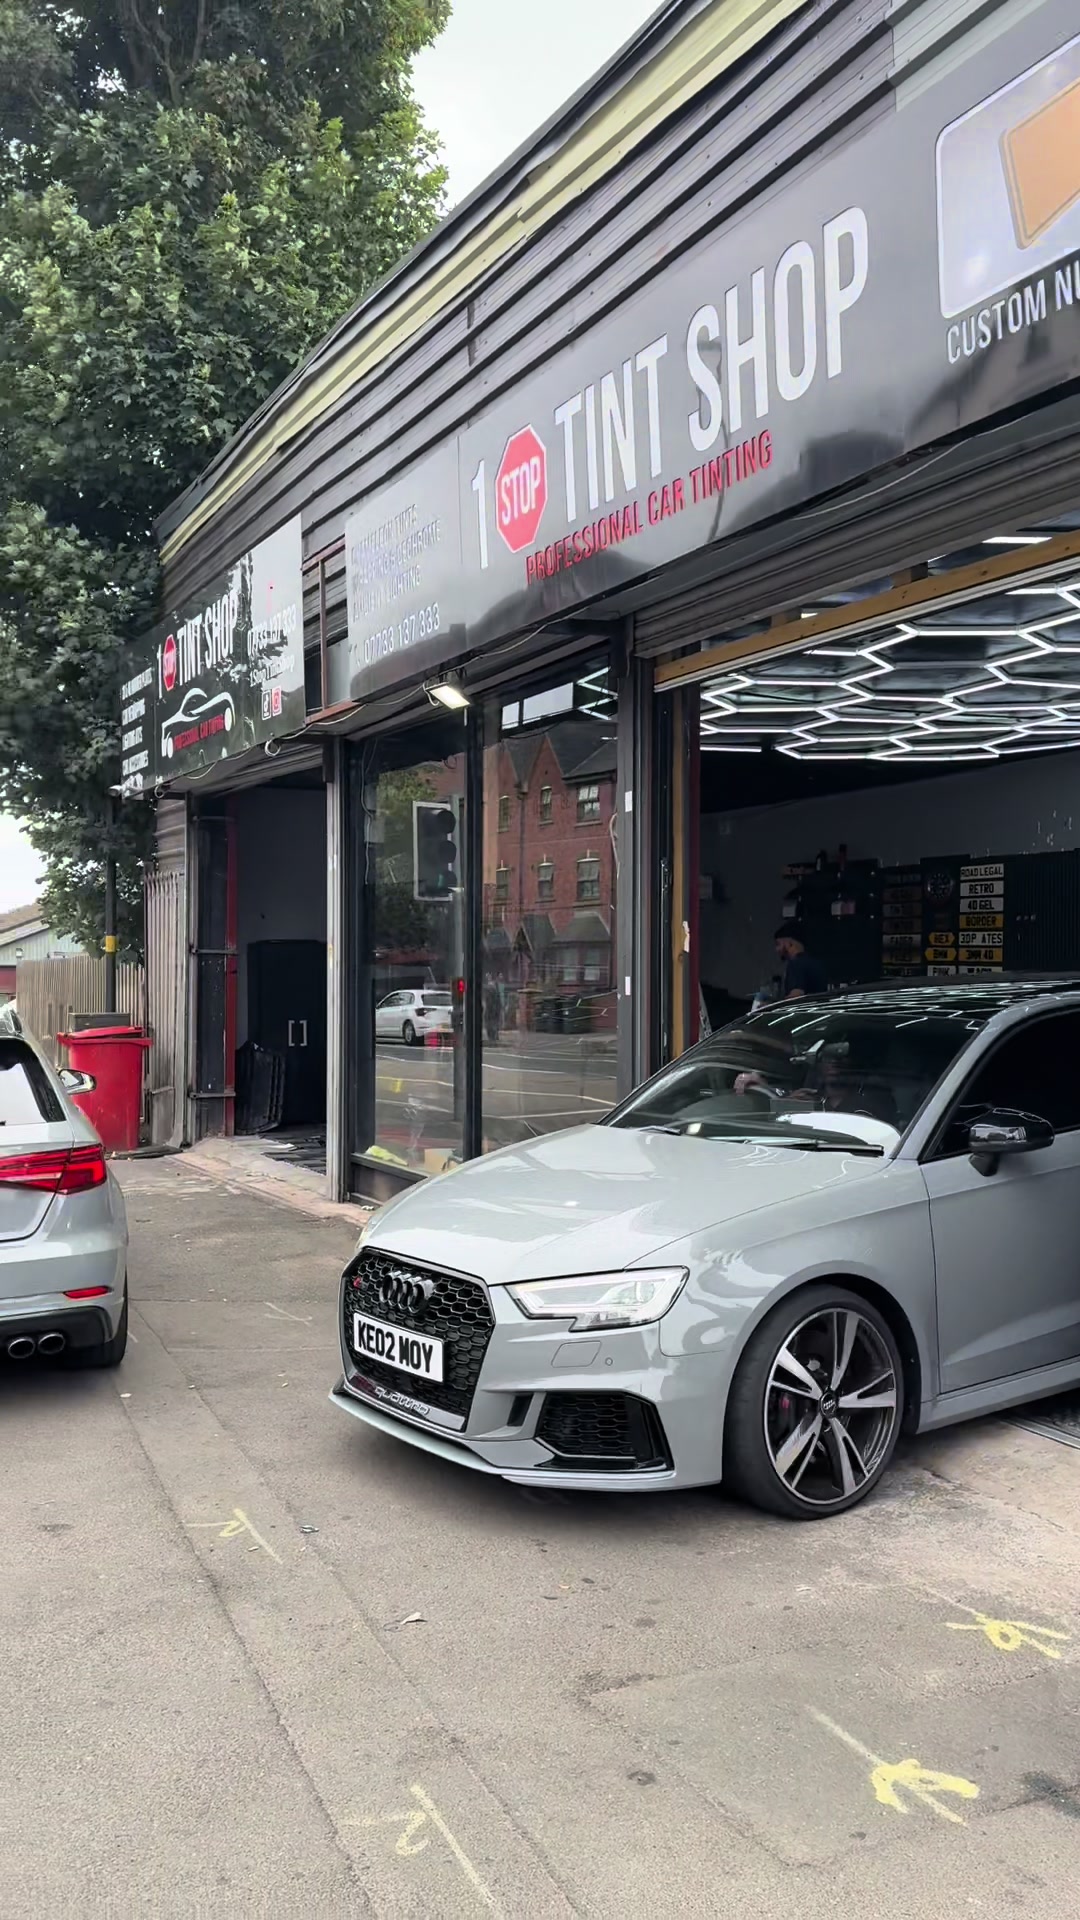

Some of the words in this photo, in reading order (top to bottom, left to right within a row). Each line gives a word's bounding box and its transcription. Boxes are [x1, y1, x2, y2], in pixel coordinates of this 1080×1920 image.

[947, 279, 1047, 365] CUSTOM
[470, 458, 489, 570] 1
[501, 456, 542, 527] STOP
[554, 333, 668, 523] TINT
[686, 206, 869, 452] SHOP
[525, 503, 644, 586] PROFESSIONAL
[647, 477, 685, 525] CAR
[689, 429, 774, 506] TINTING
[177, 613, 203, 687] TINT
[204, 588, 239, 670] SHOP
[363, 626, 395, 664] 07733
[398, 614, 416, 648] 137
[419, 601, 441, 638] 333
[960, 868, 979, 878] ROAD
[979, 866, 1003, 877] LEGAL
[968, 883, 995, 894] RETRO
[965, 915, 997, 927] BORDER
[967, 899, 978, 910] 4D
[979, 898, 995, 910] GEL
[357, 1319, 396, 1363] KE02
[398, 1336, 434, 1374] MOY
